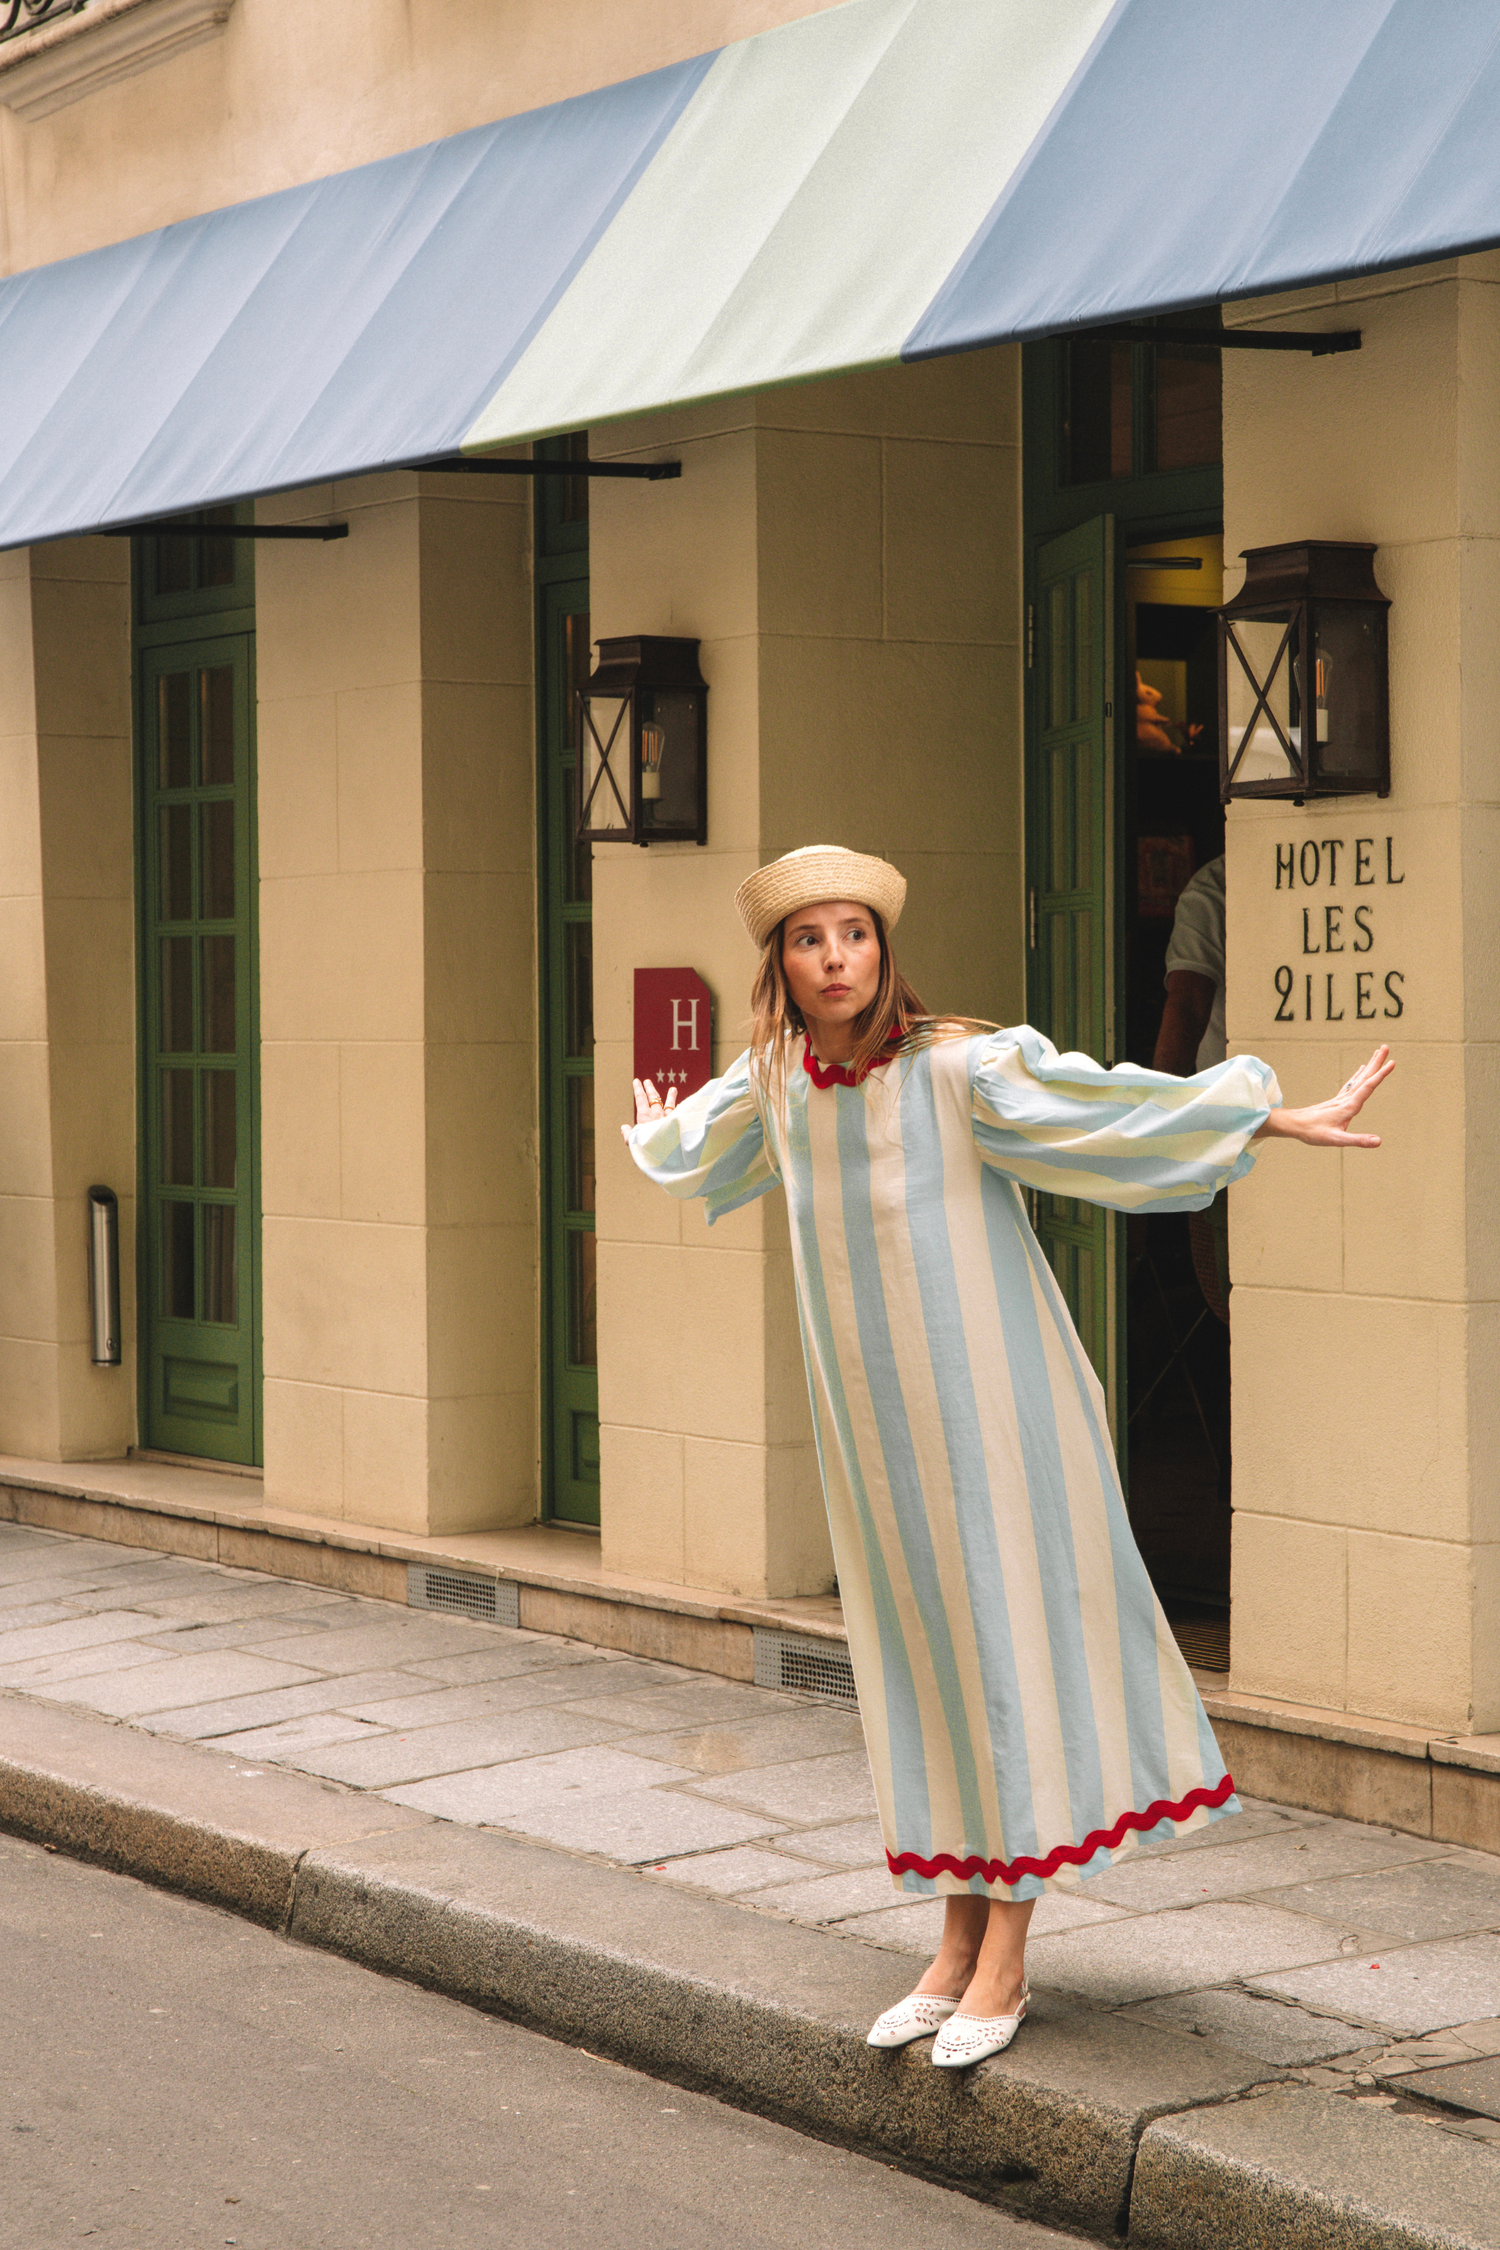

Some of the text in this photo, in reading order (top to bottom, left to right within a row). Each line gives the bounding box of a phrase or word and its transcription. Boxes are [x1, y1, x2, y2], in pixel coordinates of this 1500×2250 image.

[1275, 837, 1405, 889] HOTEL
[1302, 905, 1374, 954] LES
[670, 999, 700, 1051] H
